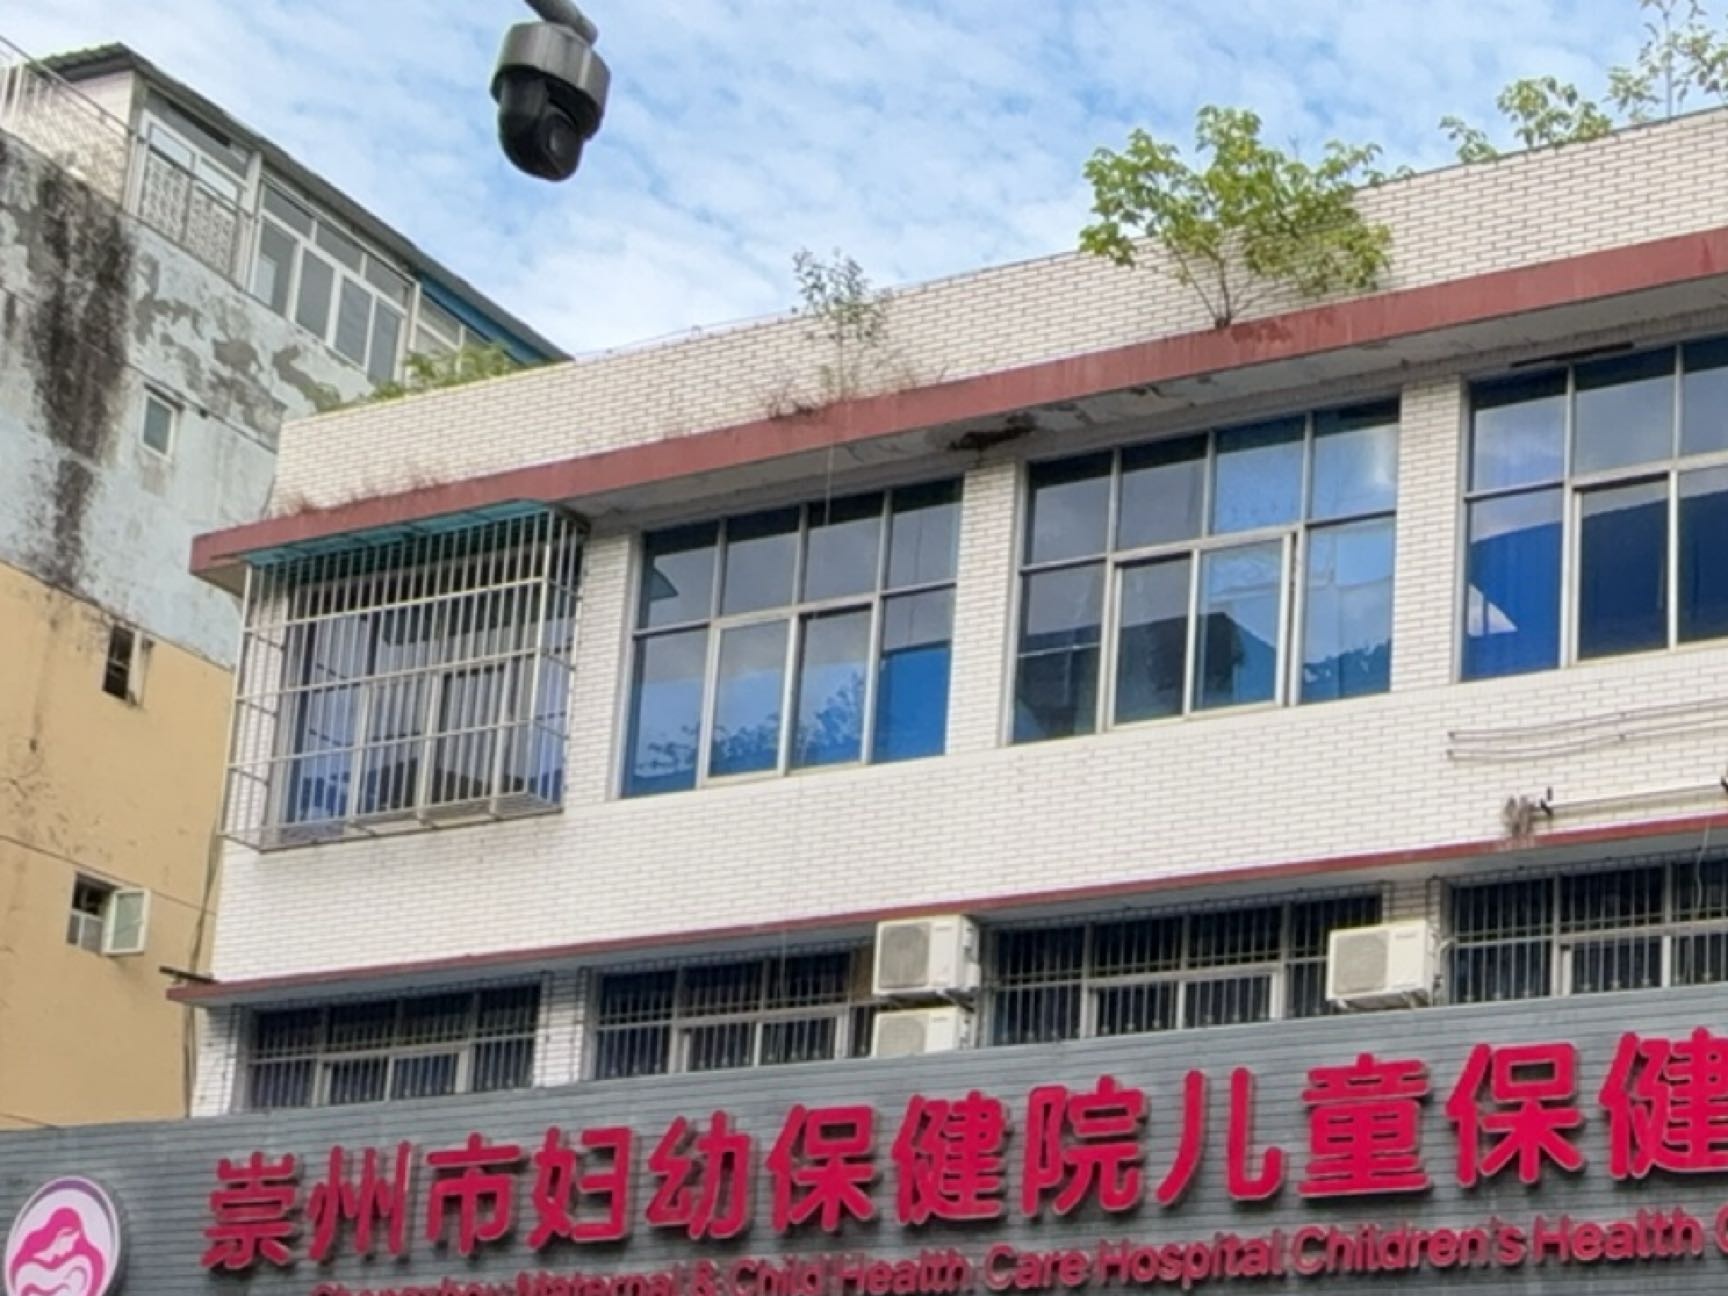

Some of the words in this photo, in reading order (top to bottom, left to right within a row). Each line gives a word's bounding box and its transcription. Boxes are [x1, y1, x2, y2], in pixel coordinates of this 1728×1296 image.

[984, 1243, 1090, 1290] Care
[1100, 1229, 1285, 1290] Hospital
[1292, 1216, 1527, 1275] Children's
[1533, 1210, 1705, 1264] Health
